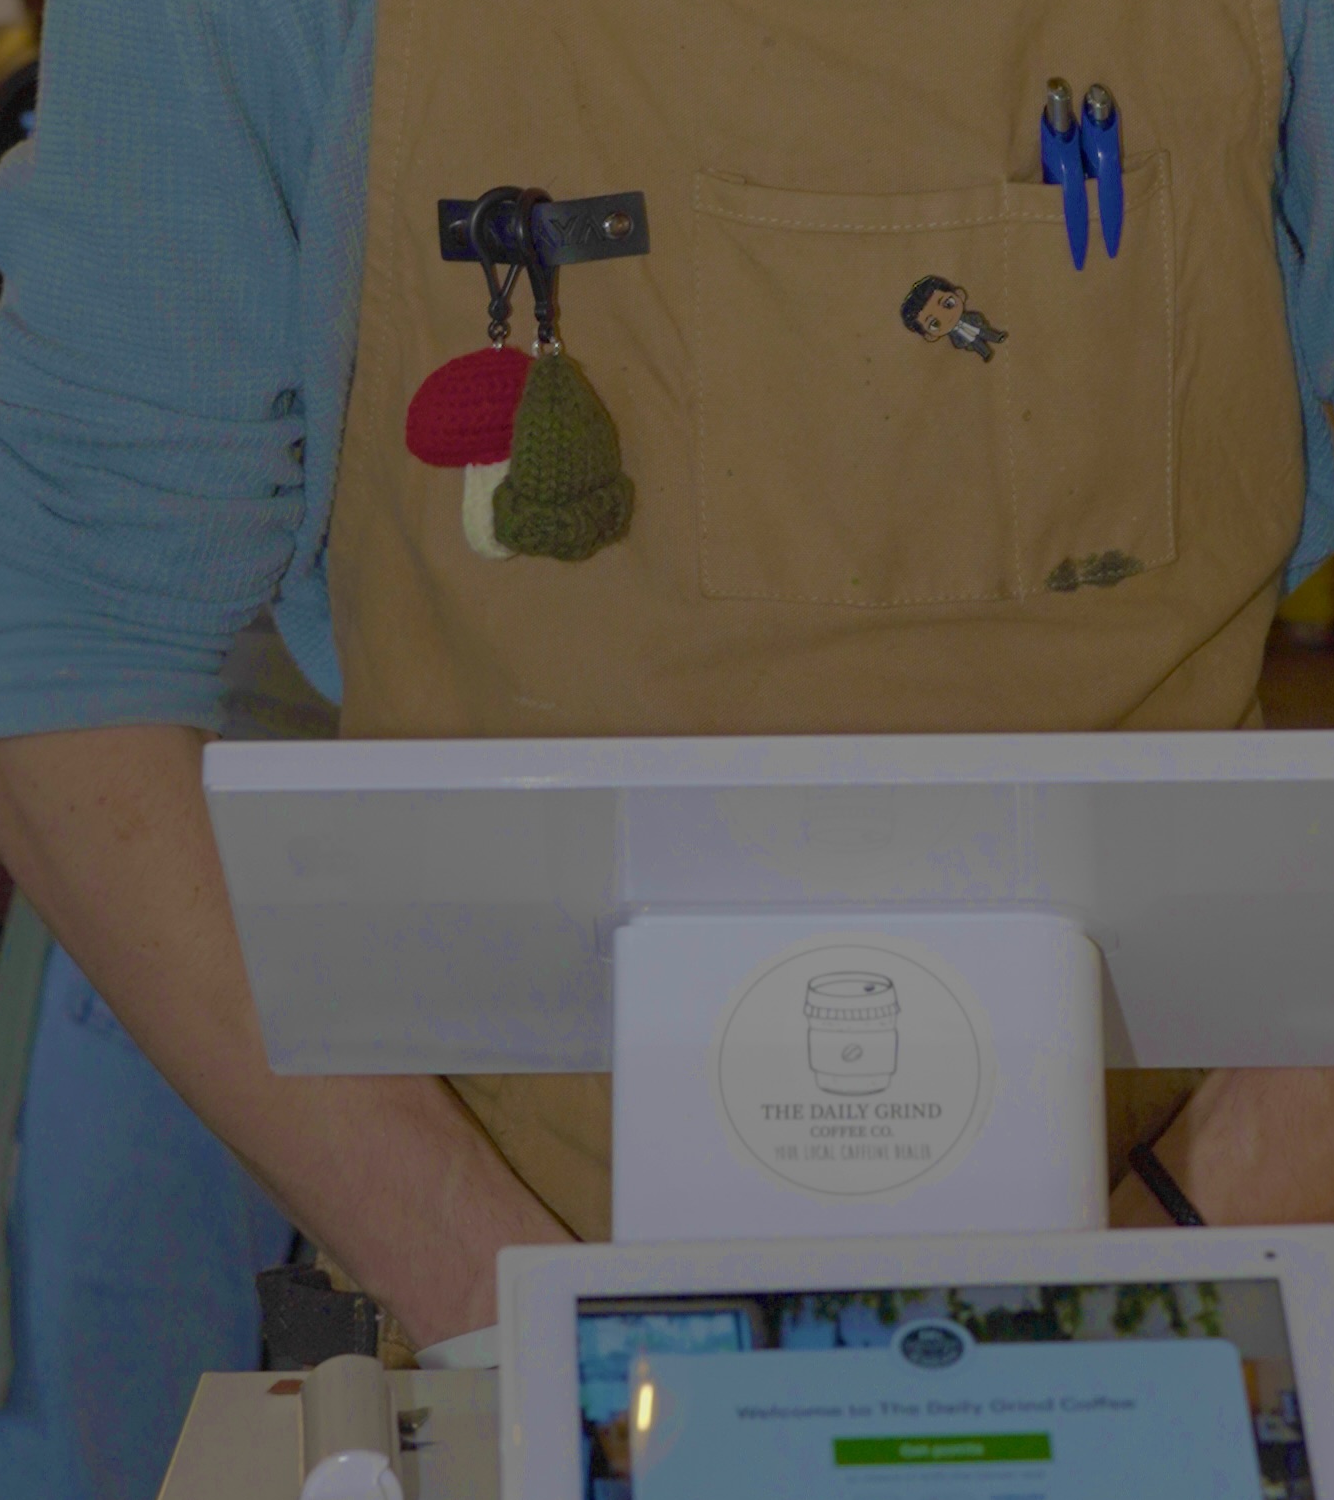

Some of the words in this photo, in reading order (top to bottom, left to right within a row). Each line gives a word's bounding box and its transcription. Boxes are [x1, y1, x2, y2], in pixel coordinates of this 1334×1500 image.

[761, 1103, 804, 1120] THE
[810, 1103, 869, 1120] DAILY
[874, 1103, 942, 1120] GRIND
[810, 1125, 867, 1138] COFFEE
[870, 1125, 895, 1138] CO.
[804, 1144, 835, 1160] LOCAL
[841, 1144, 889, 1160] CAFFEINE
[880, 1402, 920, 1417] The
[926, 1400, 983, 1417] Daily
[990, 1398, 1053, 1414] Grind
[1060, 1396, 1136, 1413] Coffee
